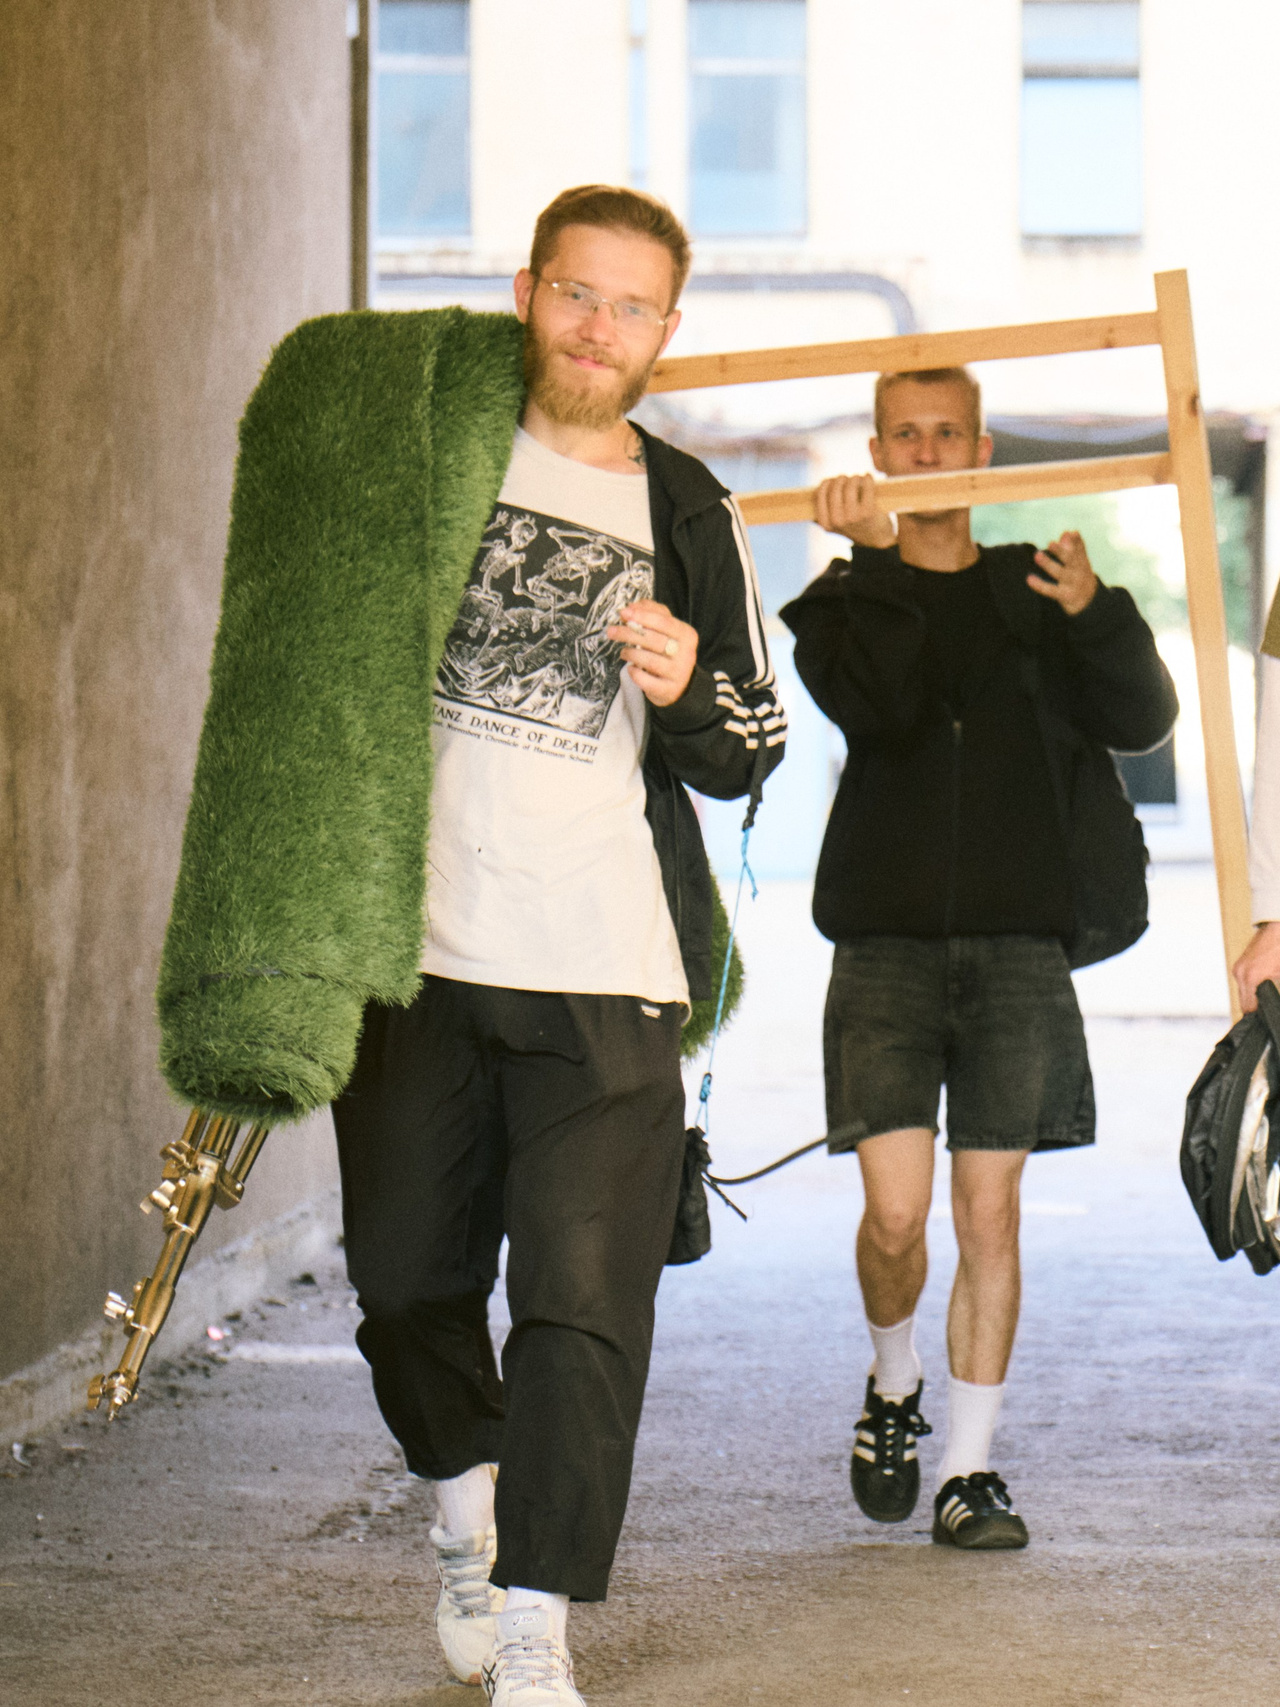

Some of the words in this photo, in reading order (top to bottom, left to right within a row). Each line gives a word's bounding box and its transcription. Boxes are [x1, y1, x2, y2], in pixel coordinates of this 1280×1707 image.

[470, 716, 521, 738] DANCE
[527, 731, 548, 743] OF
[553, 737, 598, 756] DEATH
[485, 734, 519, 747] Chronicle
